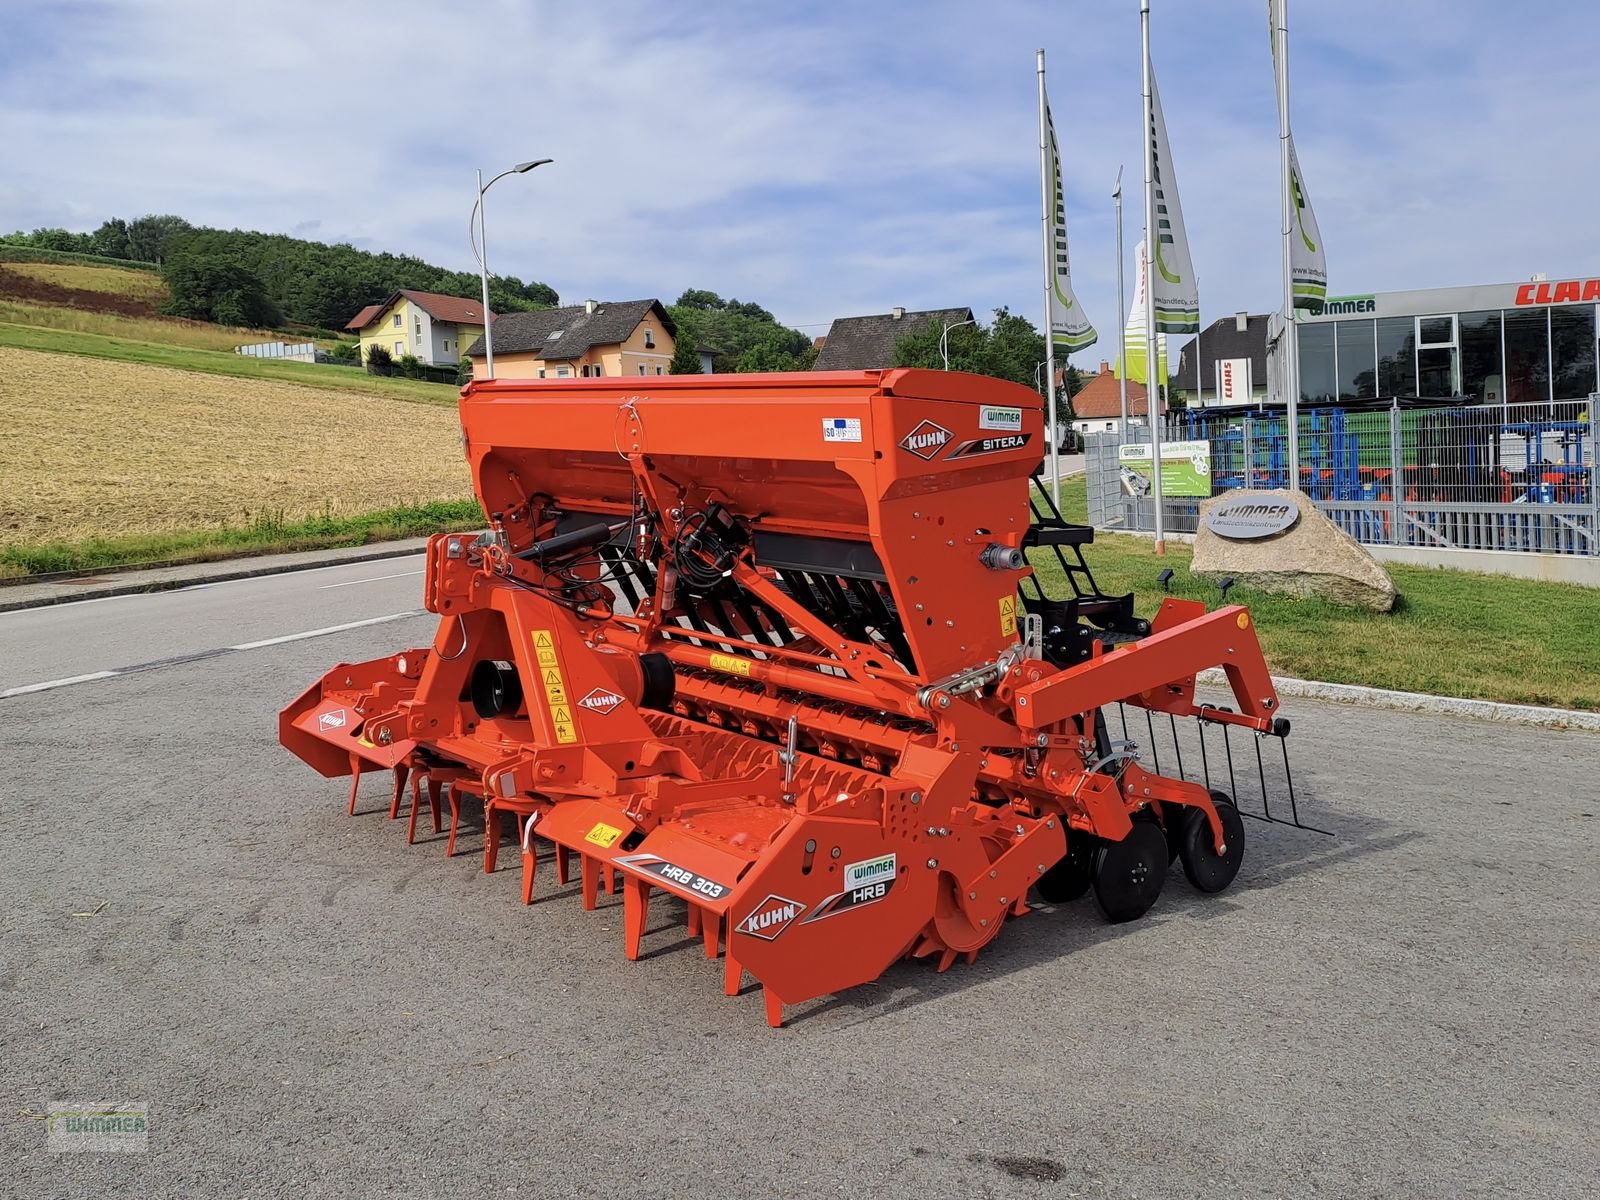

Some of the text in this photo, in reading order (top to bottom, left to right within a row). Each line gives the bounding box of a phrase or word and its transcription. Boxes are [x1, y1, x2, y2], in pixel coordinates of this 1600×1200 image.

[1223, 362, 1233, 399] CLAAS
[987, 411, 1020, 423] WIMMER
[907, 431, 946, 450] KUHN
[982, 436, 1025, 450] SITERA
[1218, 504, 1290, 519] WIMMER
[585, 695, 618, 708] KUHN
[854, 860, 894, 880] WIMMER
[660, 864, 724, 898] HRB 303
[853, 883, 886, 904] HRB
[748, 904, 795, 932] KUHN
